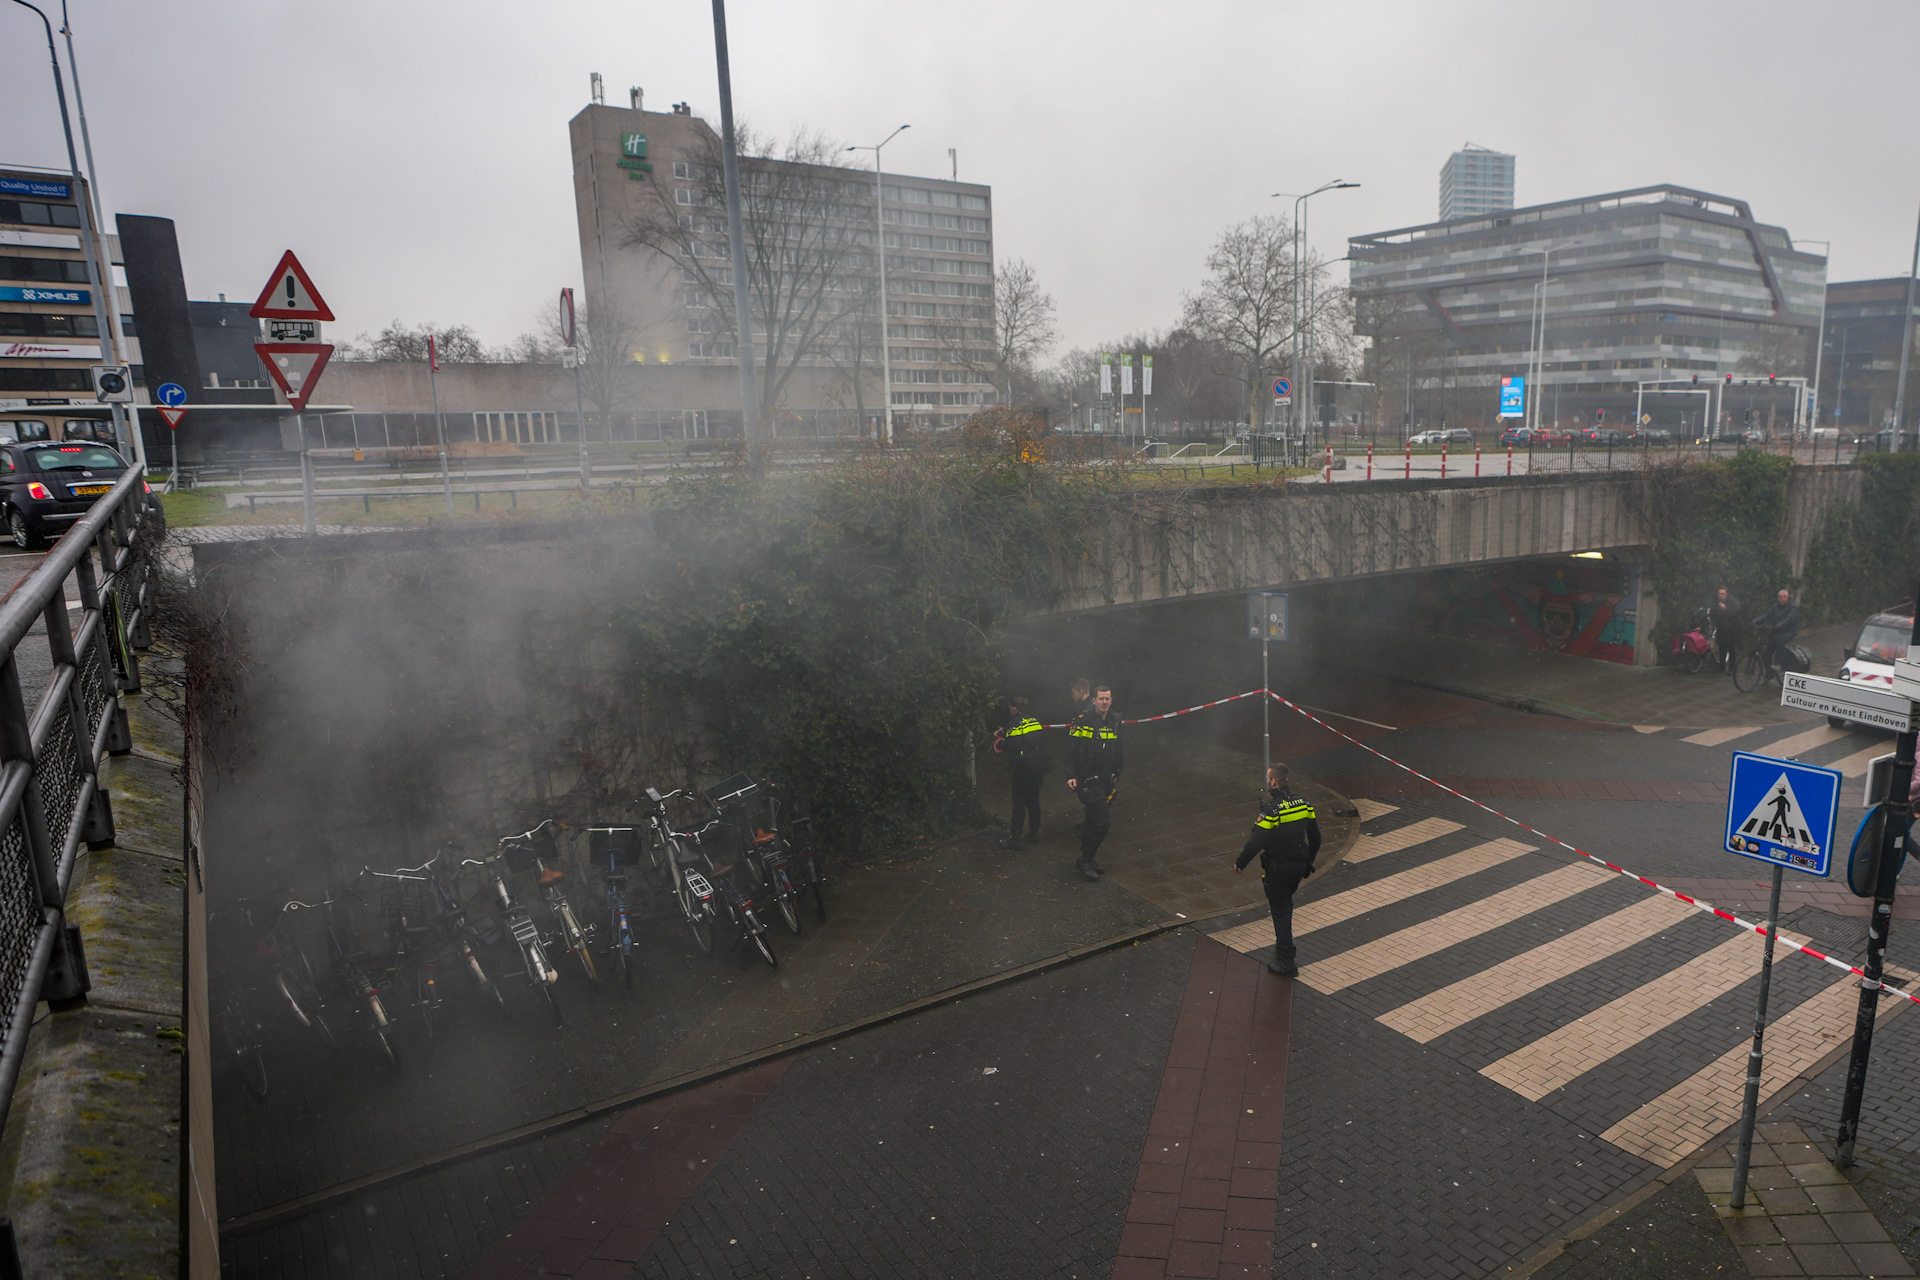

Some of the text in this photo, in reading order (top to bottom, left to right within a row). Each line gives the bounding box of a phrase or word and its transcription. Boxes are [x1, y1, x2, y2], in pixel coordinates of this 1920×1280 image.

[0, 180, 29, 190] Quality
[31, 183, 58, 192] United
[38, 291, 80, 301] XIMIUS
[1788, 678, 1807, 690] CKE
[1786, 695, 1907, 729] Cultuur en Kunst Eindhoven
